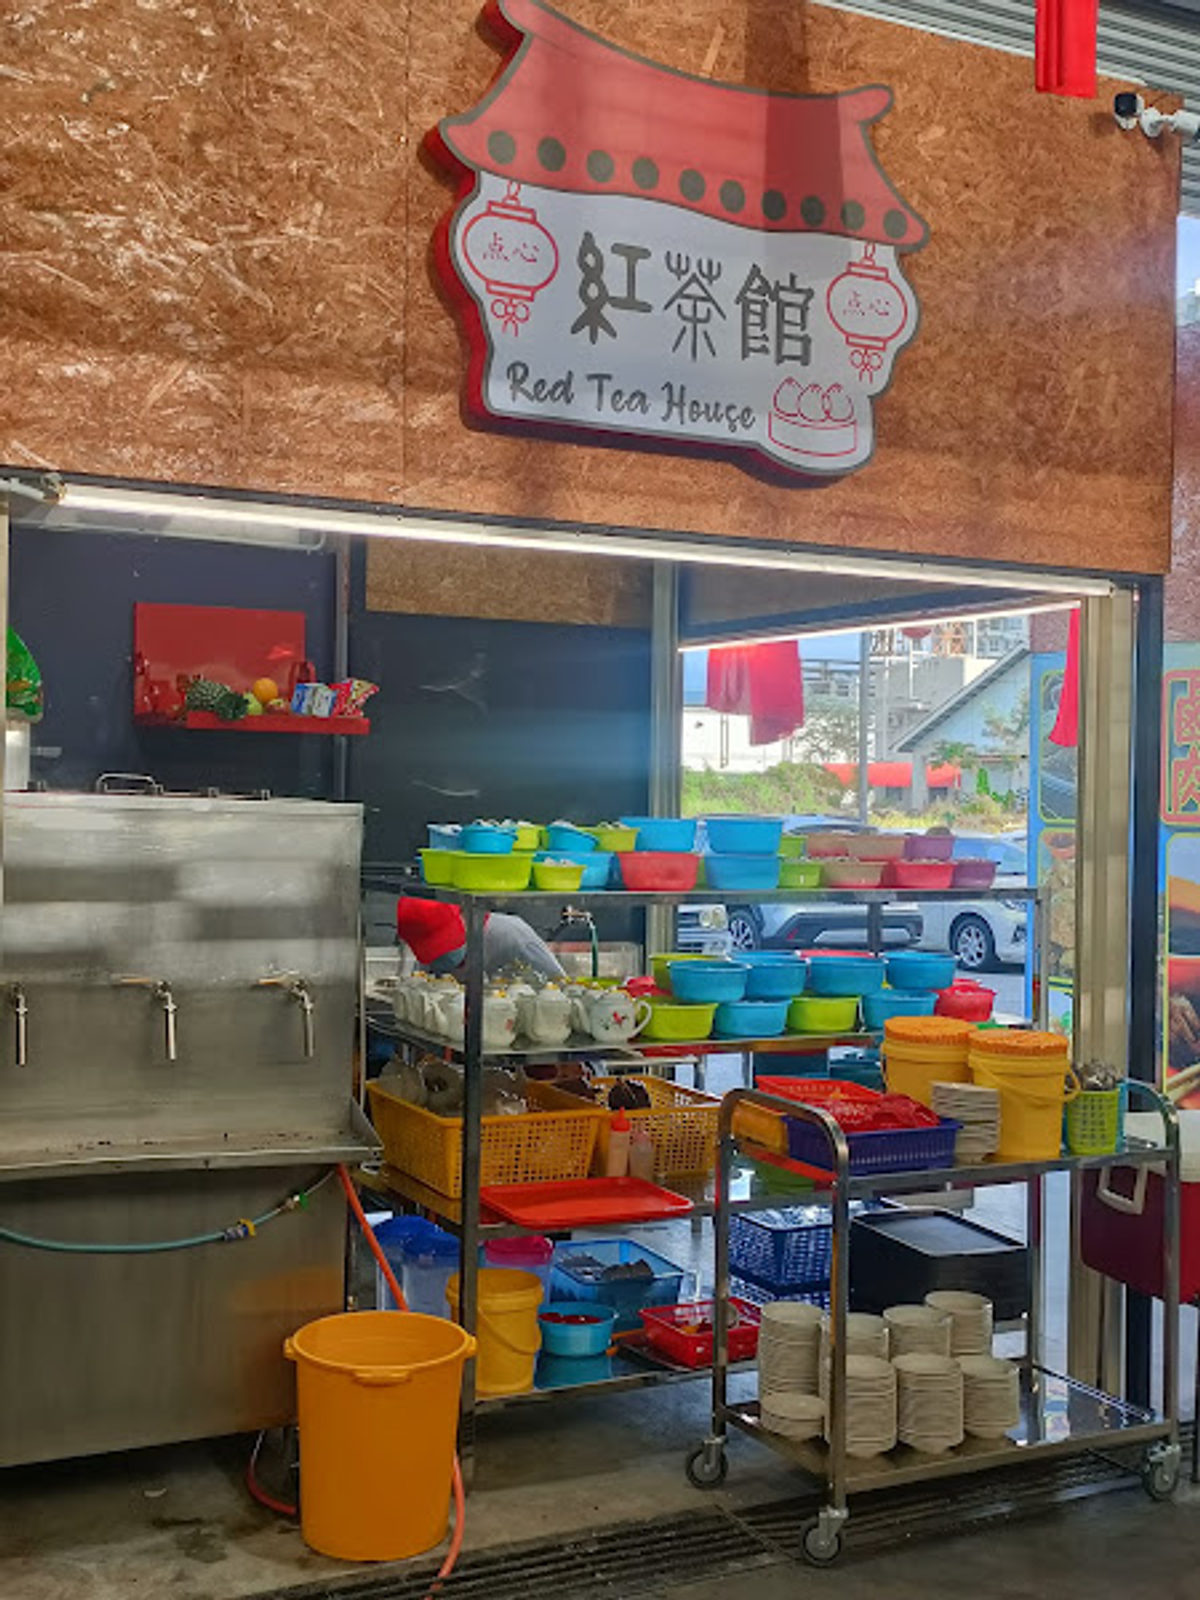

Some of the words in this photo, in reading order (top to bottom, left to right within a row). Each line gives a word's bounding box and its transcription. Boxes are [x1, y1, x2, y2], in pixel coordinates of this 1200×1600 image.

[482, 231, 540, 263] 点心
[570, 231, 816, 366] 紅茶館
[506, 360, 575, 403] Red
[586, 373, 651, 414] Tea
[661, 381, 756, 433] House
